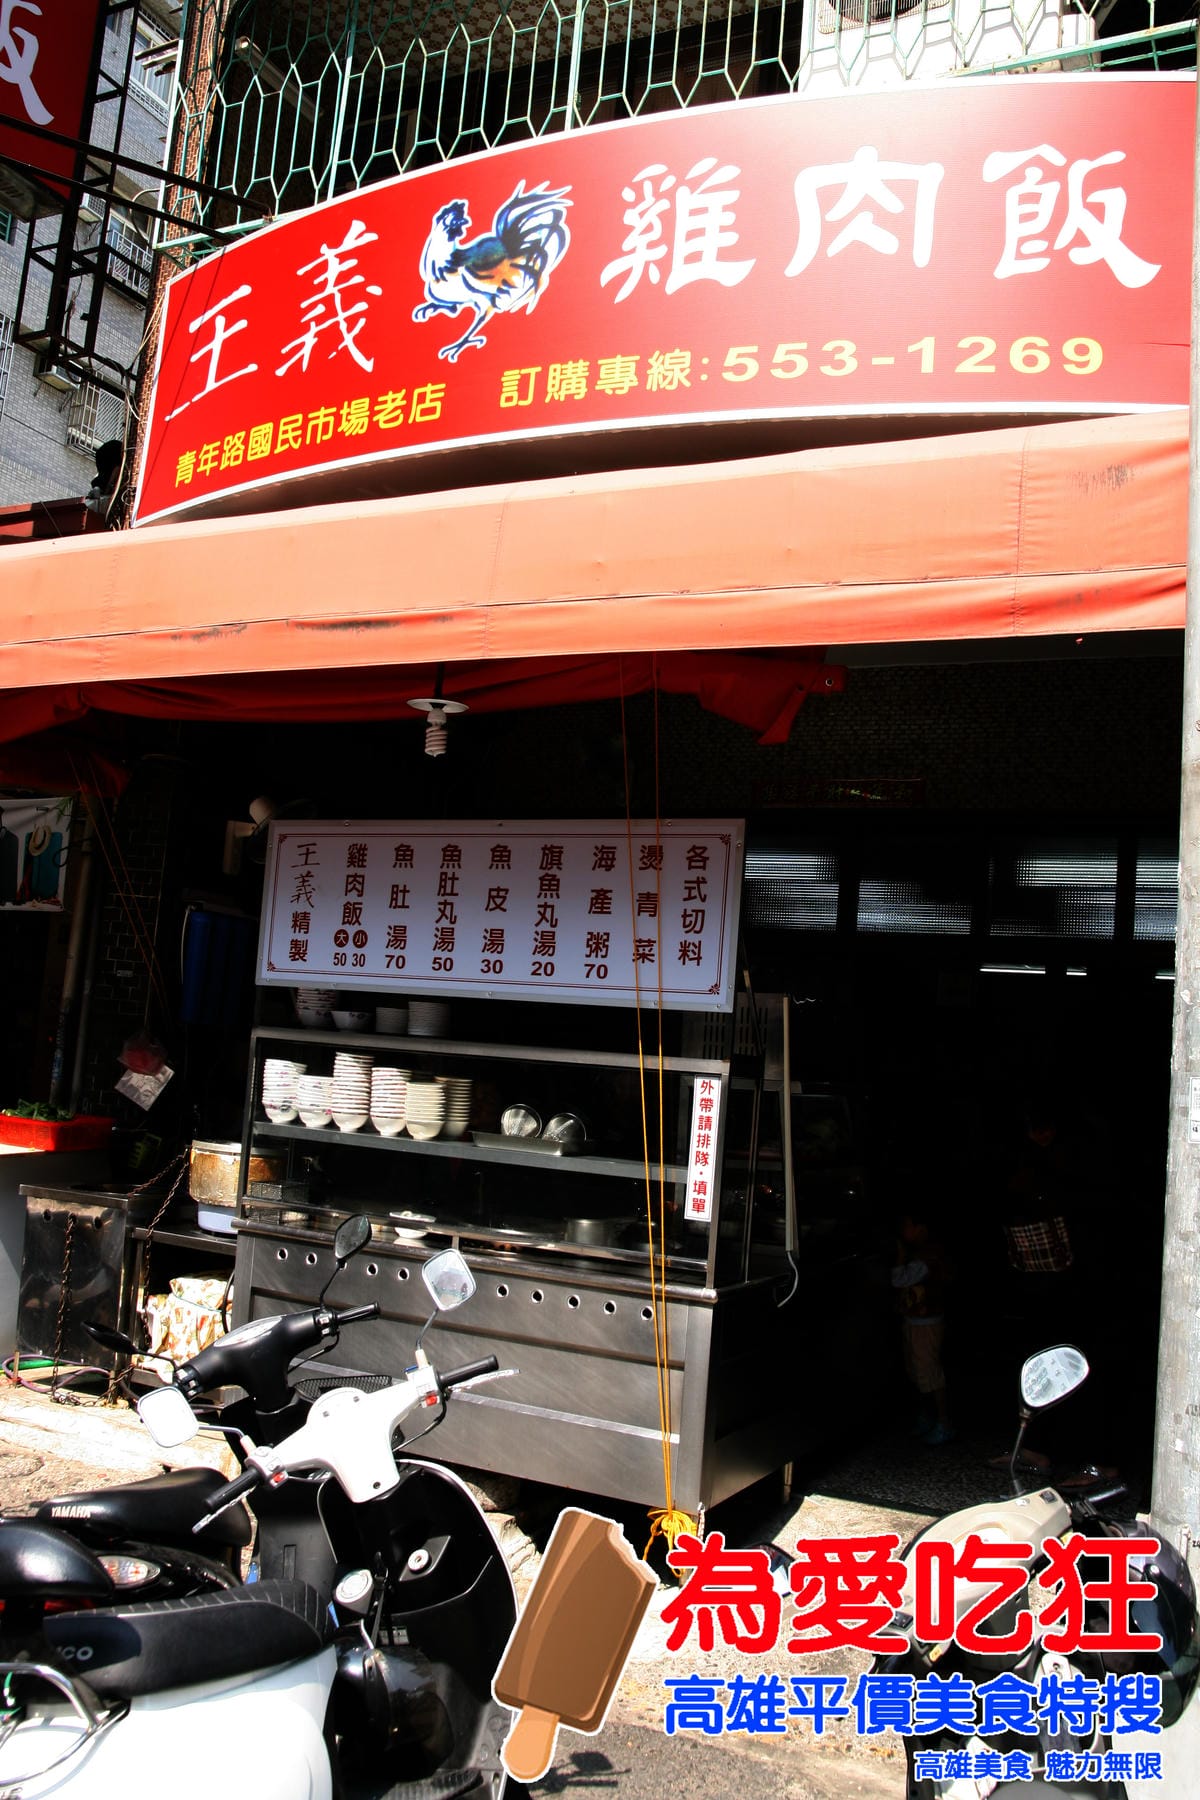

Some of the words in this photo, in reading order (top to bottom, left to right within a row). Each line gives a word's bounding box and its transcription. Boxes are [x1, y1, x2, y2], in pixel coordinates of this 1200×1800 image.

[165, 220, 382, 421] 王義
[600, 144, 1162, 304] 雞肉飯
[174, 382, 446, 488] 青年路國民市場老店
[289, 842, 320, 962] 王義精製
[341, 843, 368, 926] 雞肉飯
[385, 843, 415, 951] 魚肚湯
[432, 843, 462, 953] 魚肚丸湯
[481, 844, 512, 955] 魚皮湯
[532, 844, 564, 957] 旗魚丸湯
[584, 844, 617, 959] 海產粥
[632, 844, 665, 964] 燙青菜
[678, 844, 710, 966] 各式切料
[333, 952, 347, 967] 50
[351, 953, 366, 968] 30
[384, 954, 406, 969] 70
[431, 957, 454, 972] 50
[480, 959, 504, 975] 30
[530, 961, 555, 977] 20
[584, 963, 608, 979] 70
[51, 1505, 92, 1518] YAMAHA
